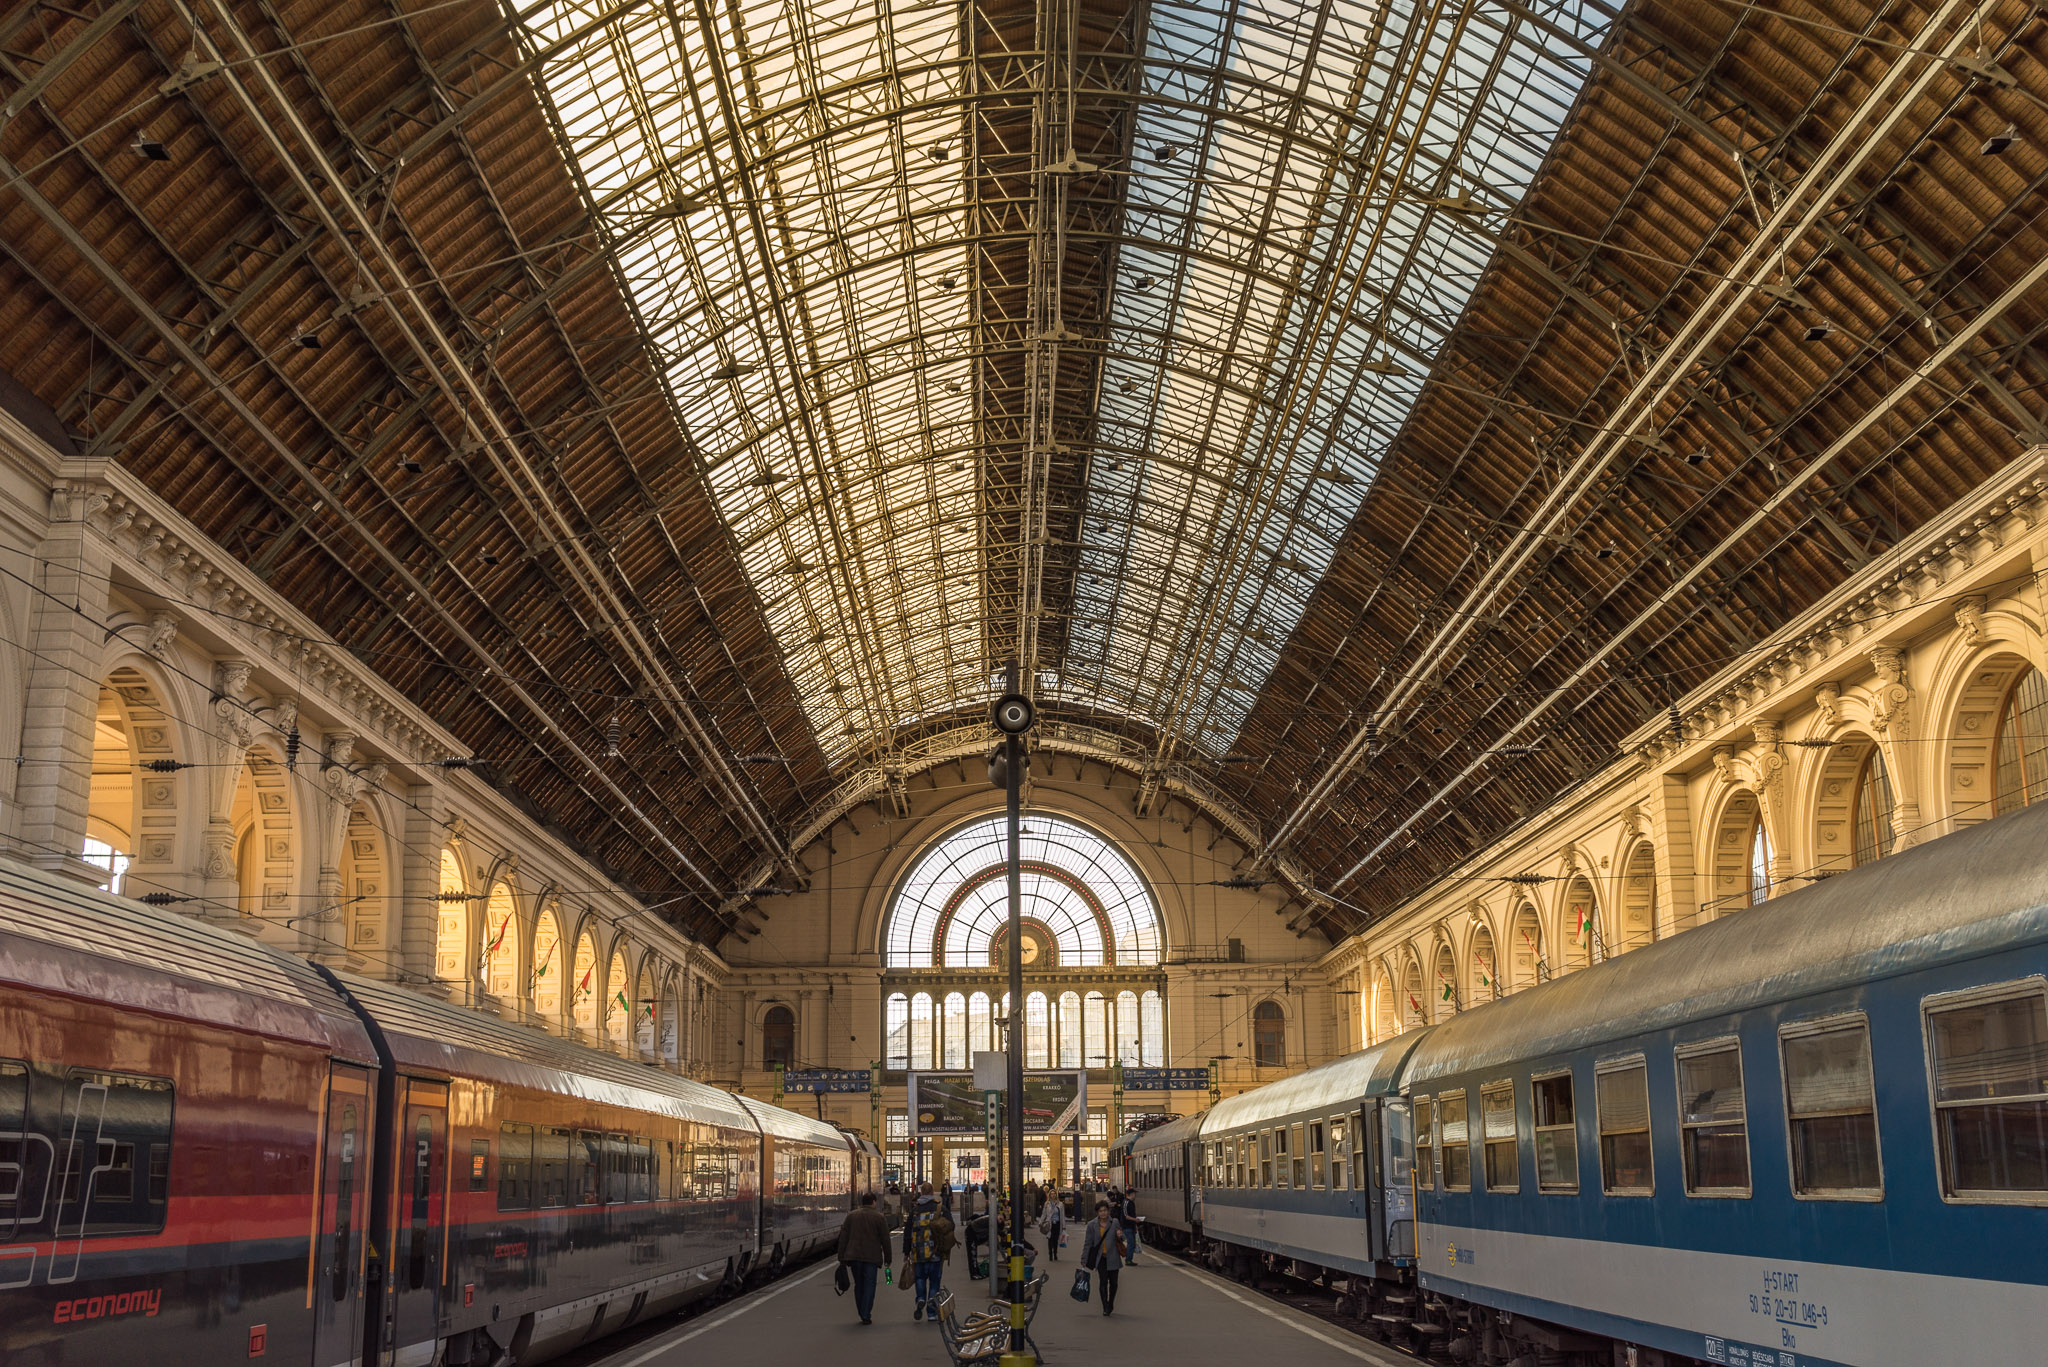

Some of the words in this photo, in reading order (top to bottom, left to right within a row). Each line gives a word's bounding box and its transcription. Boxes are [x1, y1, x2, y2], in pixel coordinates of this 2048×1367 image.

[342, 1133, 353, 1163] 2
[417, 1140, 429, 1167] 2
[494, 1241, 528, 1257] economy
[1763, 1270, 1799, 1293] H-START
[53, 1288, 162, 1324] economy
[1749, 1294, 1759, 1313] 50
[1762, 1296, 1772, 1316] 55
[1774, 1298, 1797, 1320] 20-37
[1801, 1302, 1828, 1326] 046-9
